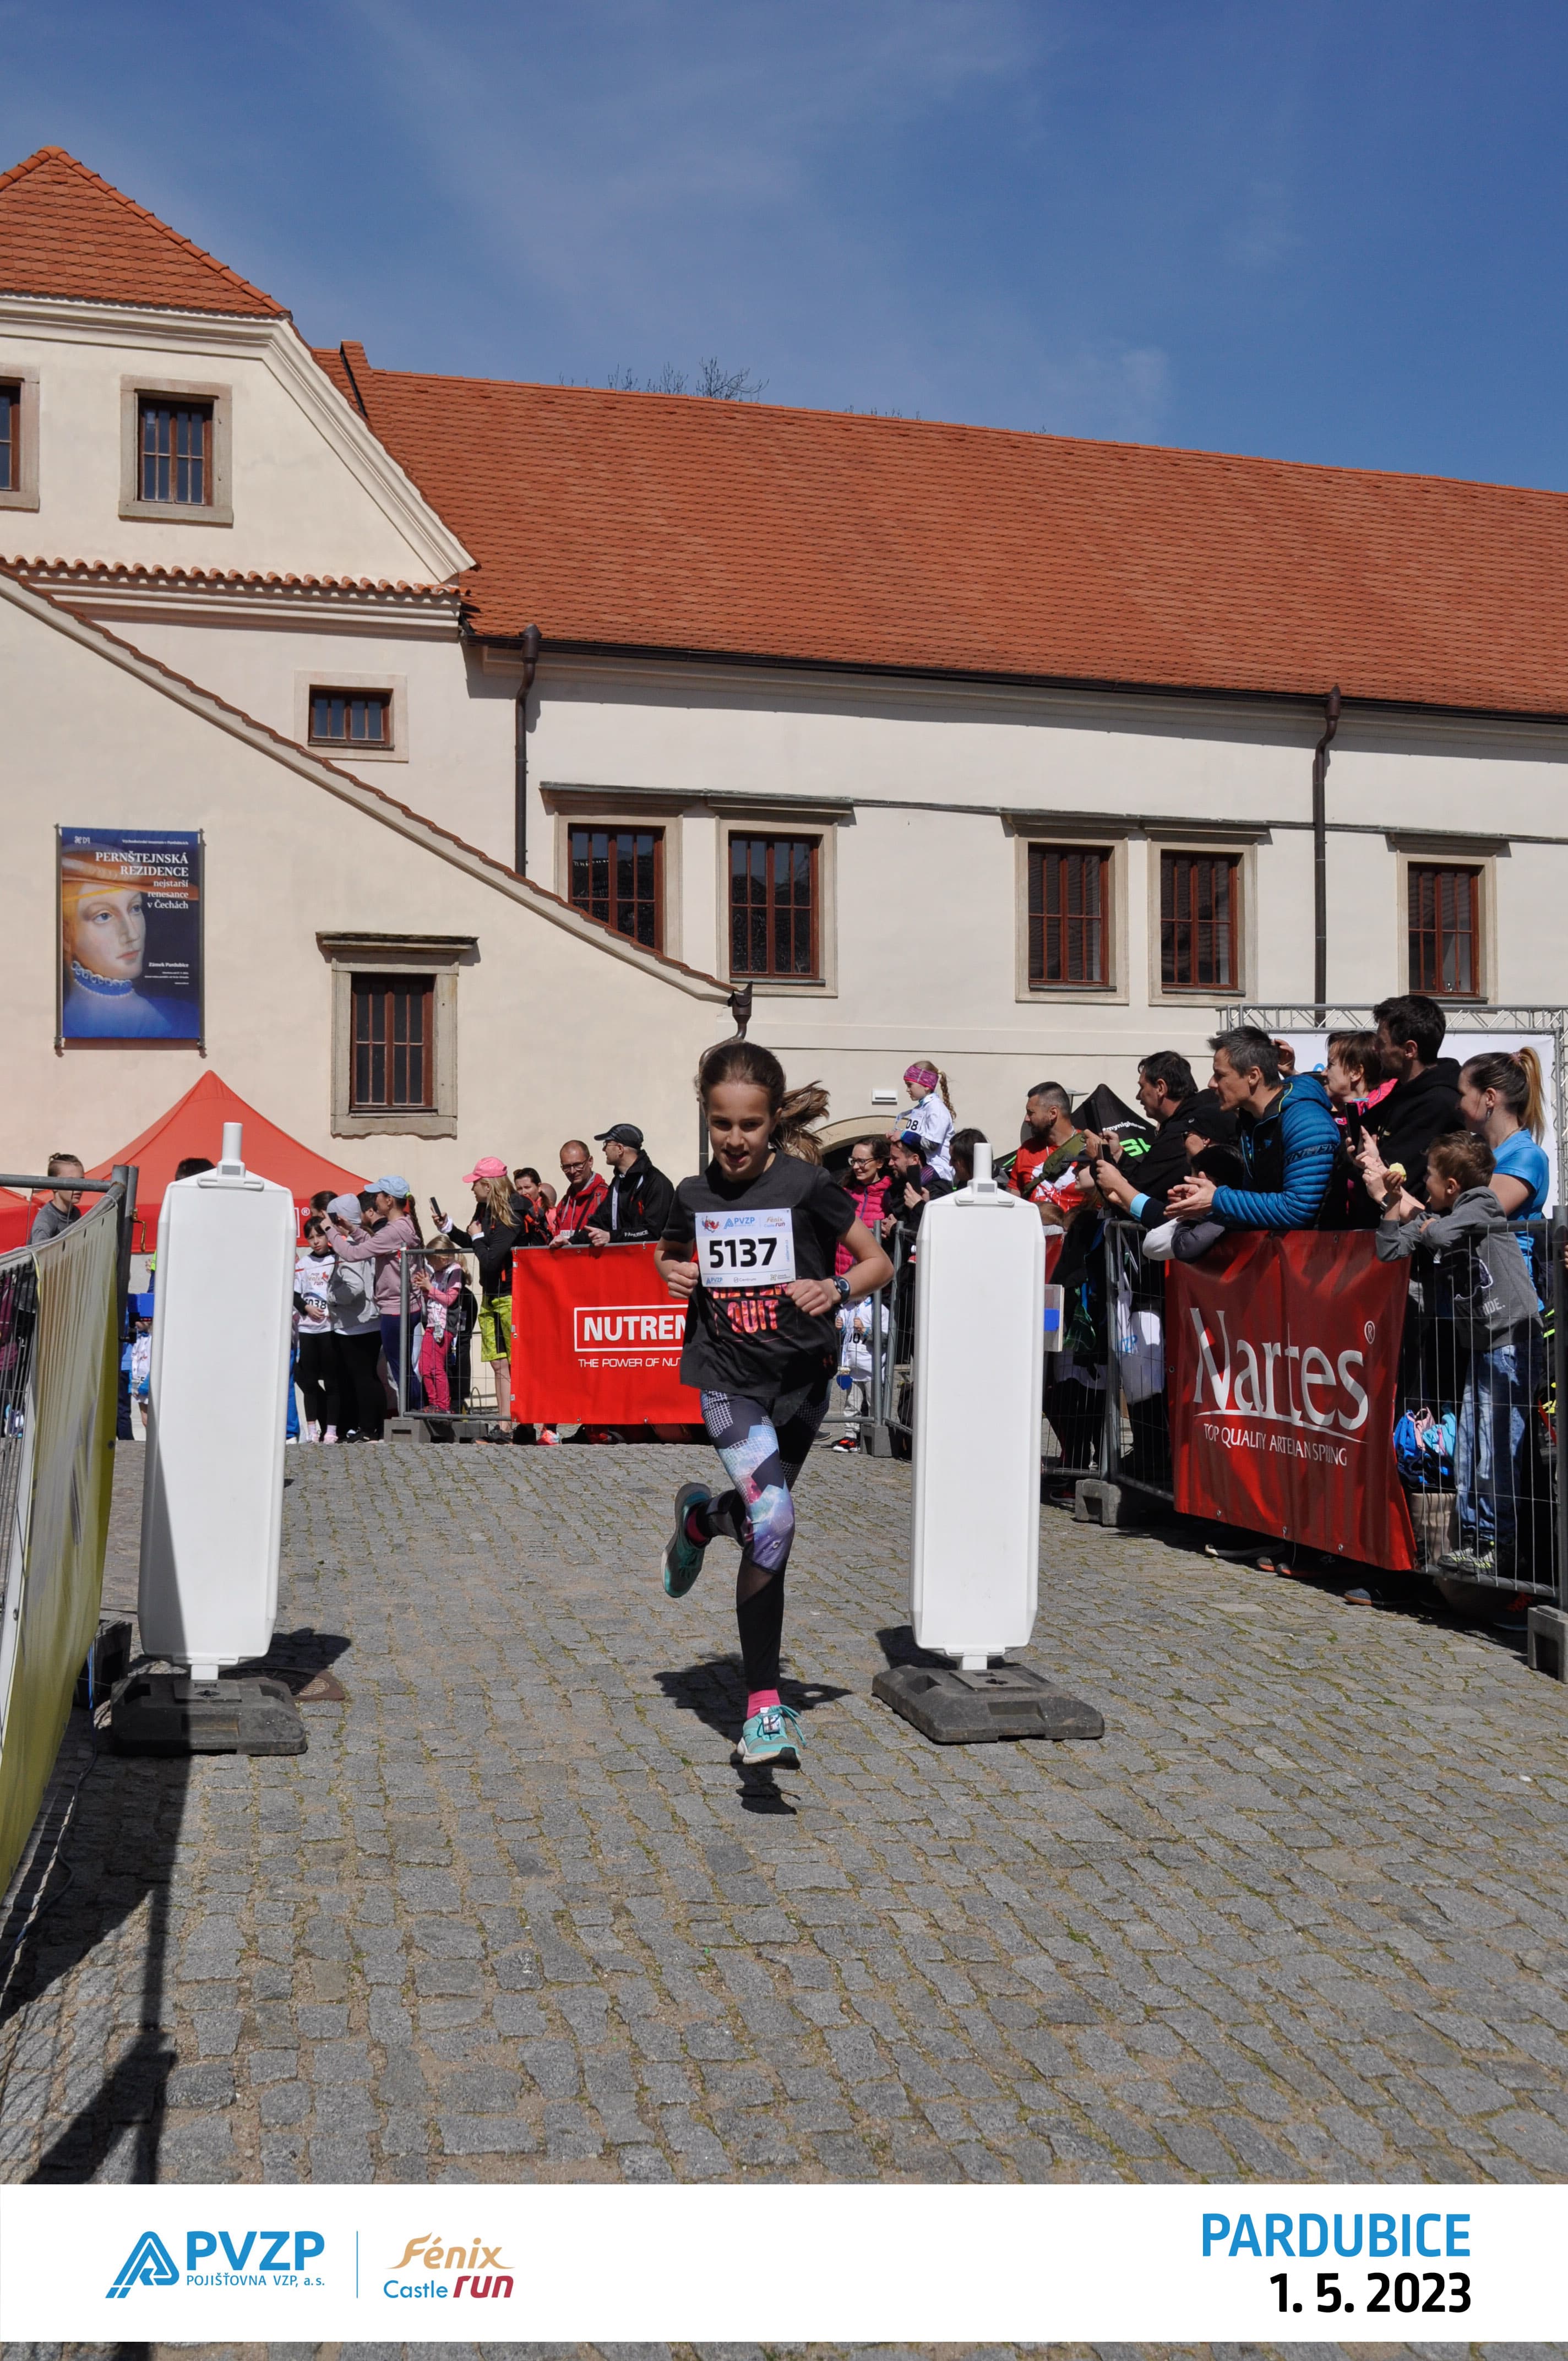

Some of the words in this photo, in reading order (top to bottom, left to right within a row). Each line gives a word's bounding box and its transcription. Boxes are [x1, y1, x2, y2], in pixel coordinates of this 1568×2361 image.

[95, 851, 188, 864] PERNŠTEJNSKÁ
[121, 866, 188, 877] REZIDENCE
[154, 879, 188, 889] nejstarší
[154, 900, 188, 909] Čechách
[734, 1216, 755, 1225] PVZP
[710, 1238, 777, 1268] 5137
[727, 1299, 779, 1334] QUIT
[584, 1314, 686, 1341] NUTREN
[578, 1358, 599, 1368] THE
[602, 1358, 643, 1368] POWER
[645, 1357, 660, 1367] OF
[1189, 1308, 1368, 1430] Nartes
[1204, 1423, 1219, 1442] TOP
